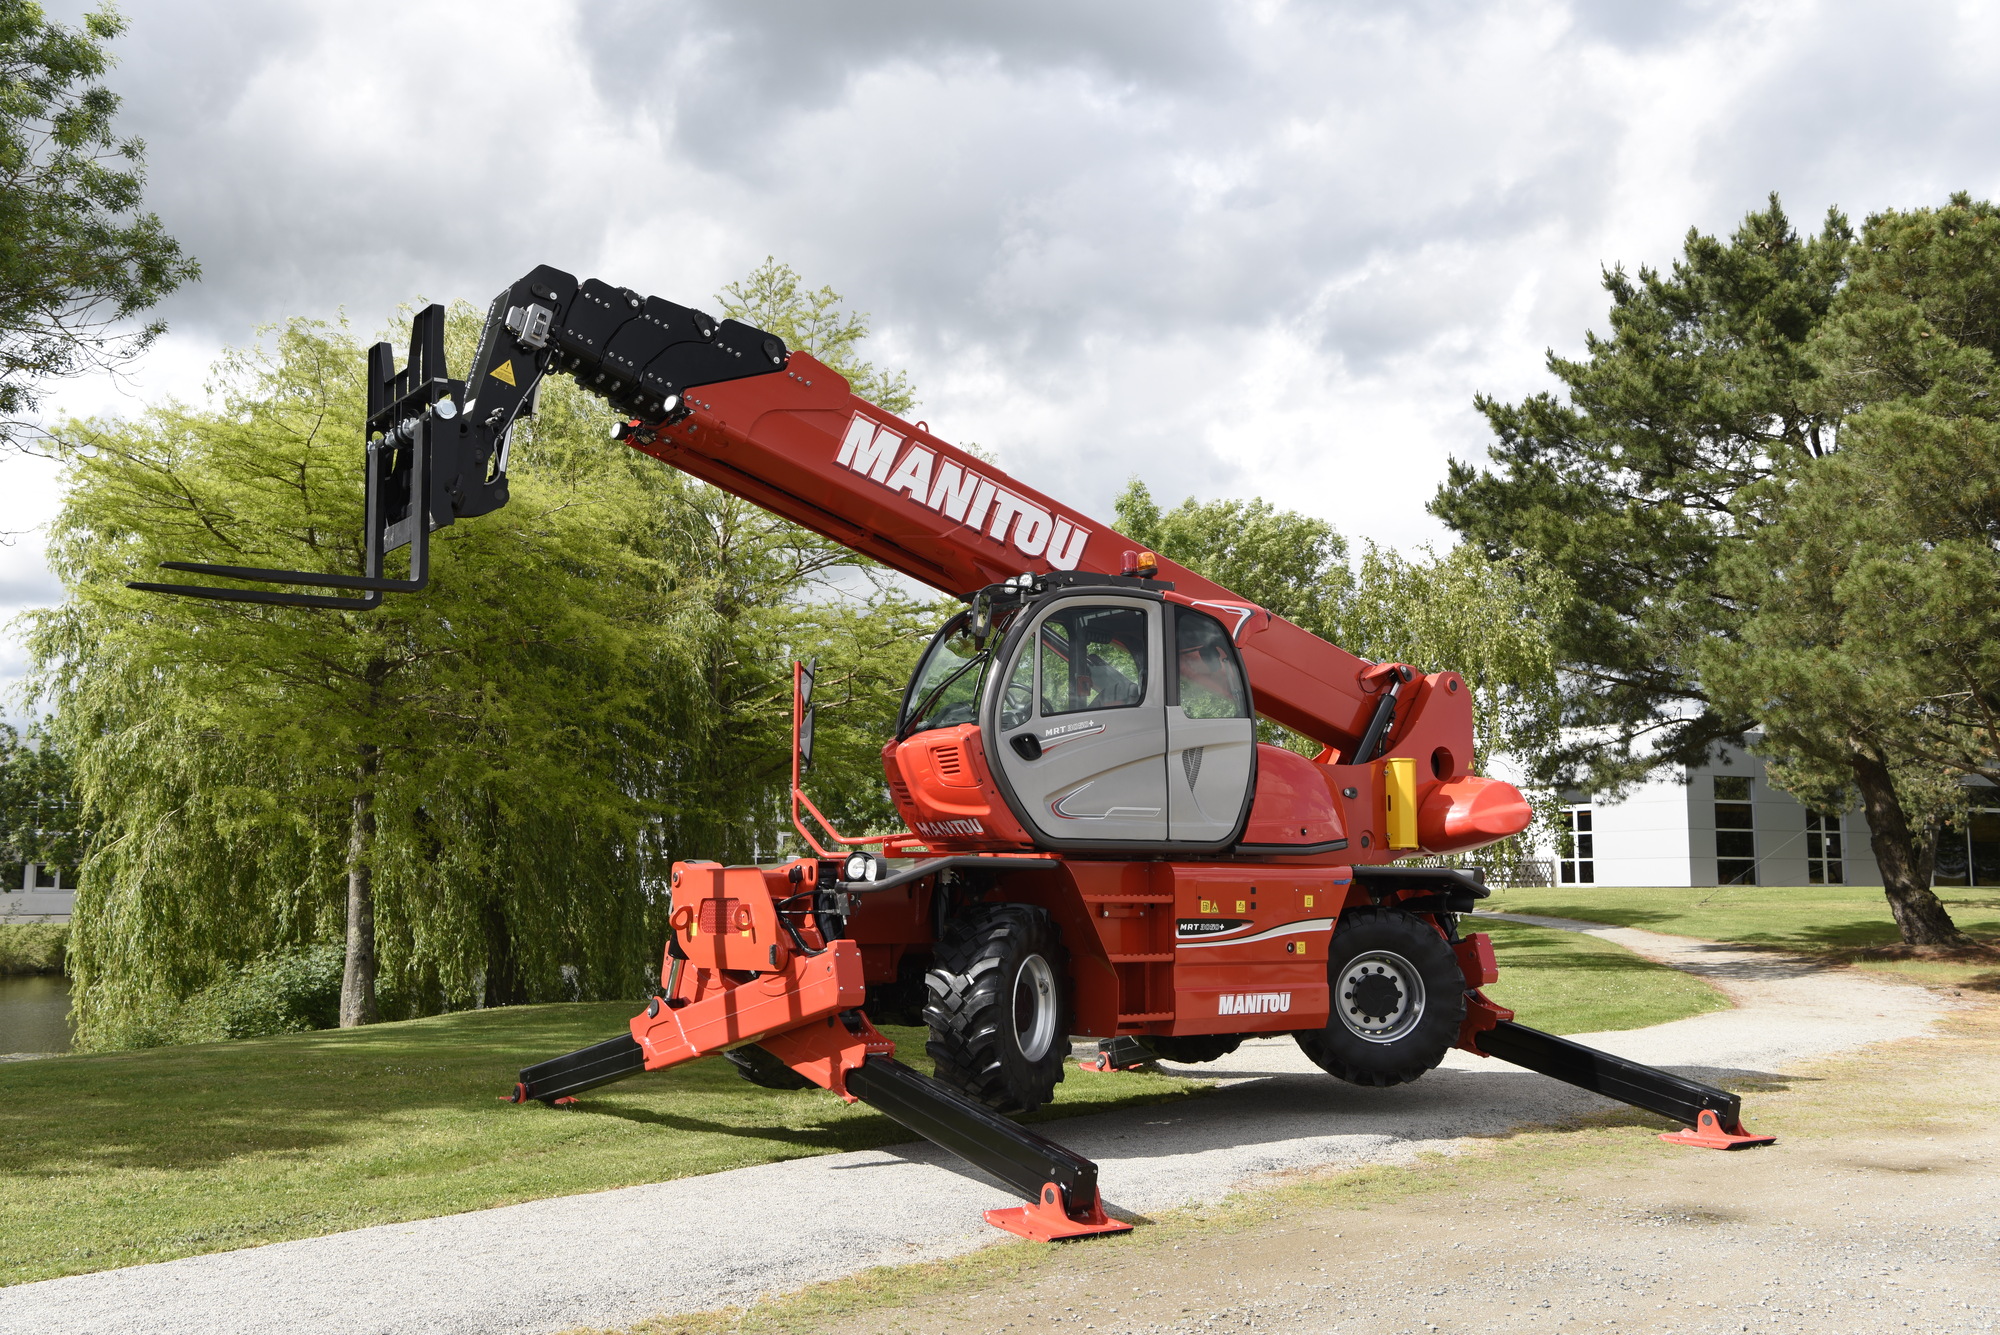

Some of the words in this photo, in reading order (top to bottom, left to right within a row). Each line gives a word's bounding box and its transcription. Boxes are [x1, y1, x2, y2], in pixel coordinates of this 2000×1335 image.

[835, 413, 1090, 571] MANITOU
[1045, 725, 1067, 737] MRT
[916, 818, 985, 837] MANITOU
[1179, 923, 1200, 931] MRT
[1217, 992, 1292, 1016] MANITOU
